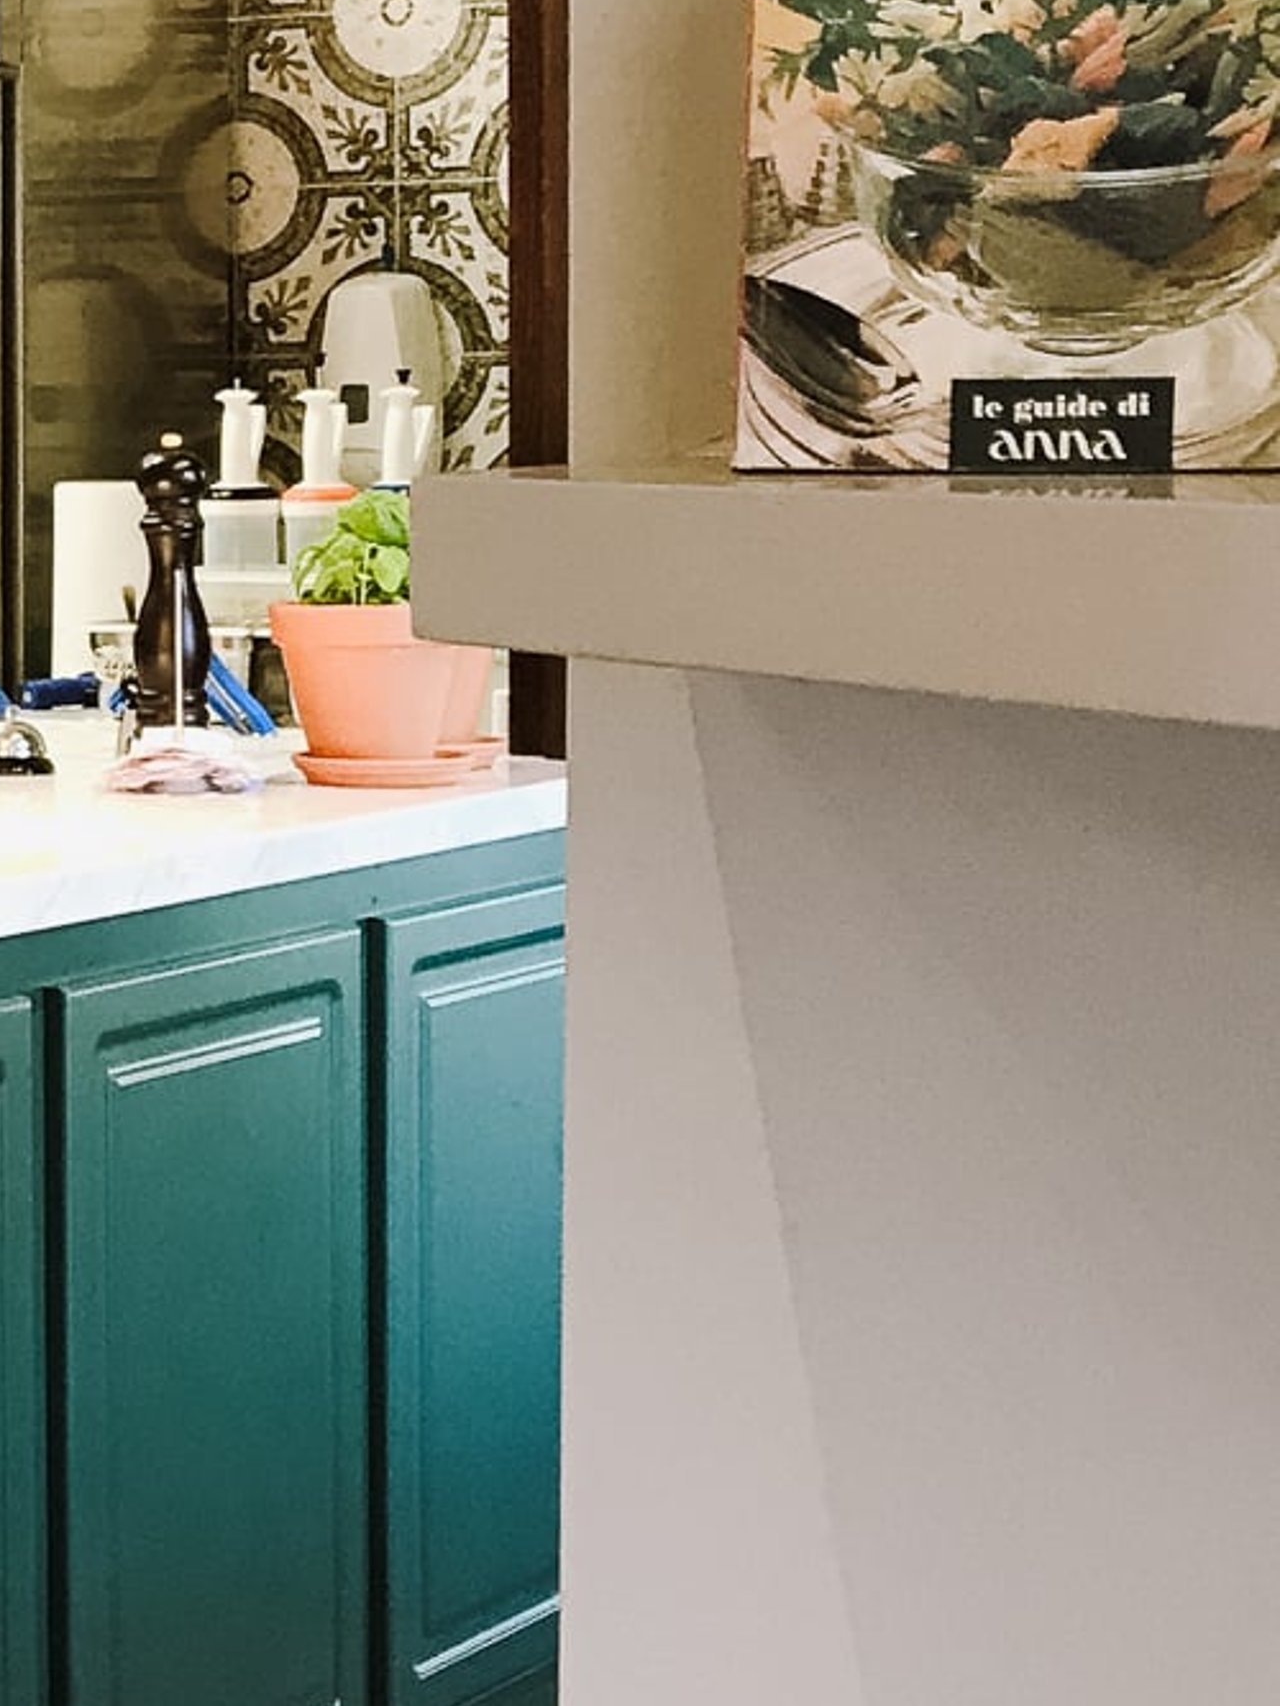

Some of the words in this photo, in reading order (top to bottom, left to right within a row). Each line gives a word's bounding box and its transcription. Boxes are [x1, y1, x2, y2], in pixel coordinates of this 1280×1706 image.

[971, 394, 1005, 419] le
[1012, 393, 1108, 425] guide
[1116, 392, 1151, 417] di
[987, 428, 1129, 462] anna
